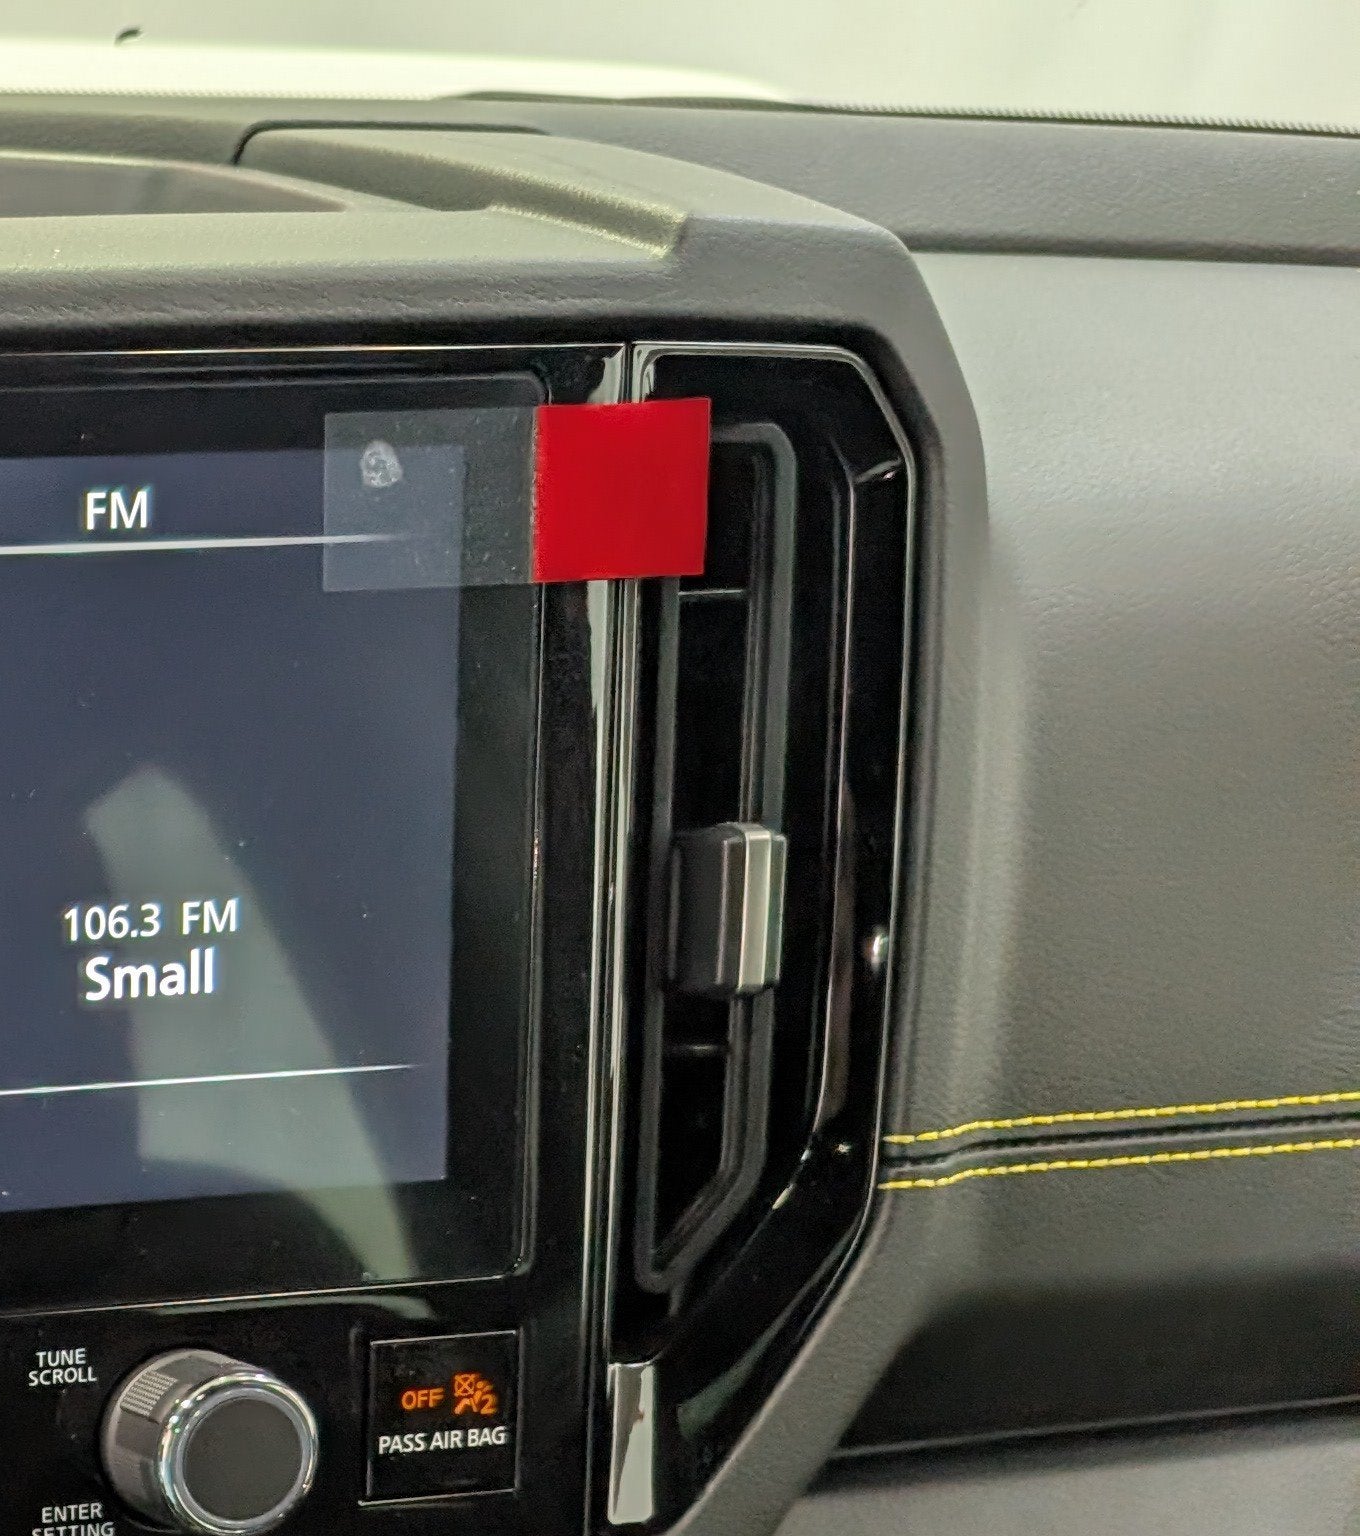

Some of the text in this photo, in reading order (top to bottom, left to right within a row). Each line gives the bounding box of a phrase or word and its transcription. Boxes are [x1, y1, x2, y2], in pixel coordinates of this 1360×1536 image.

[85, 491, 148, 530] FM
[64, 898, 239, 942] 106.3 FM
[85, 947, 214, 1001] Small
[36, 1348, 86, 1367] TUNE
[28, 1365, 97, 1387] SCROLL
[401, 1388, 444, 1411] OFF
[378, 1426, 508, 1456] PASS AIR BAG
[41, 1502, 102, 1524] ENTER
